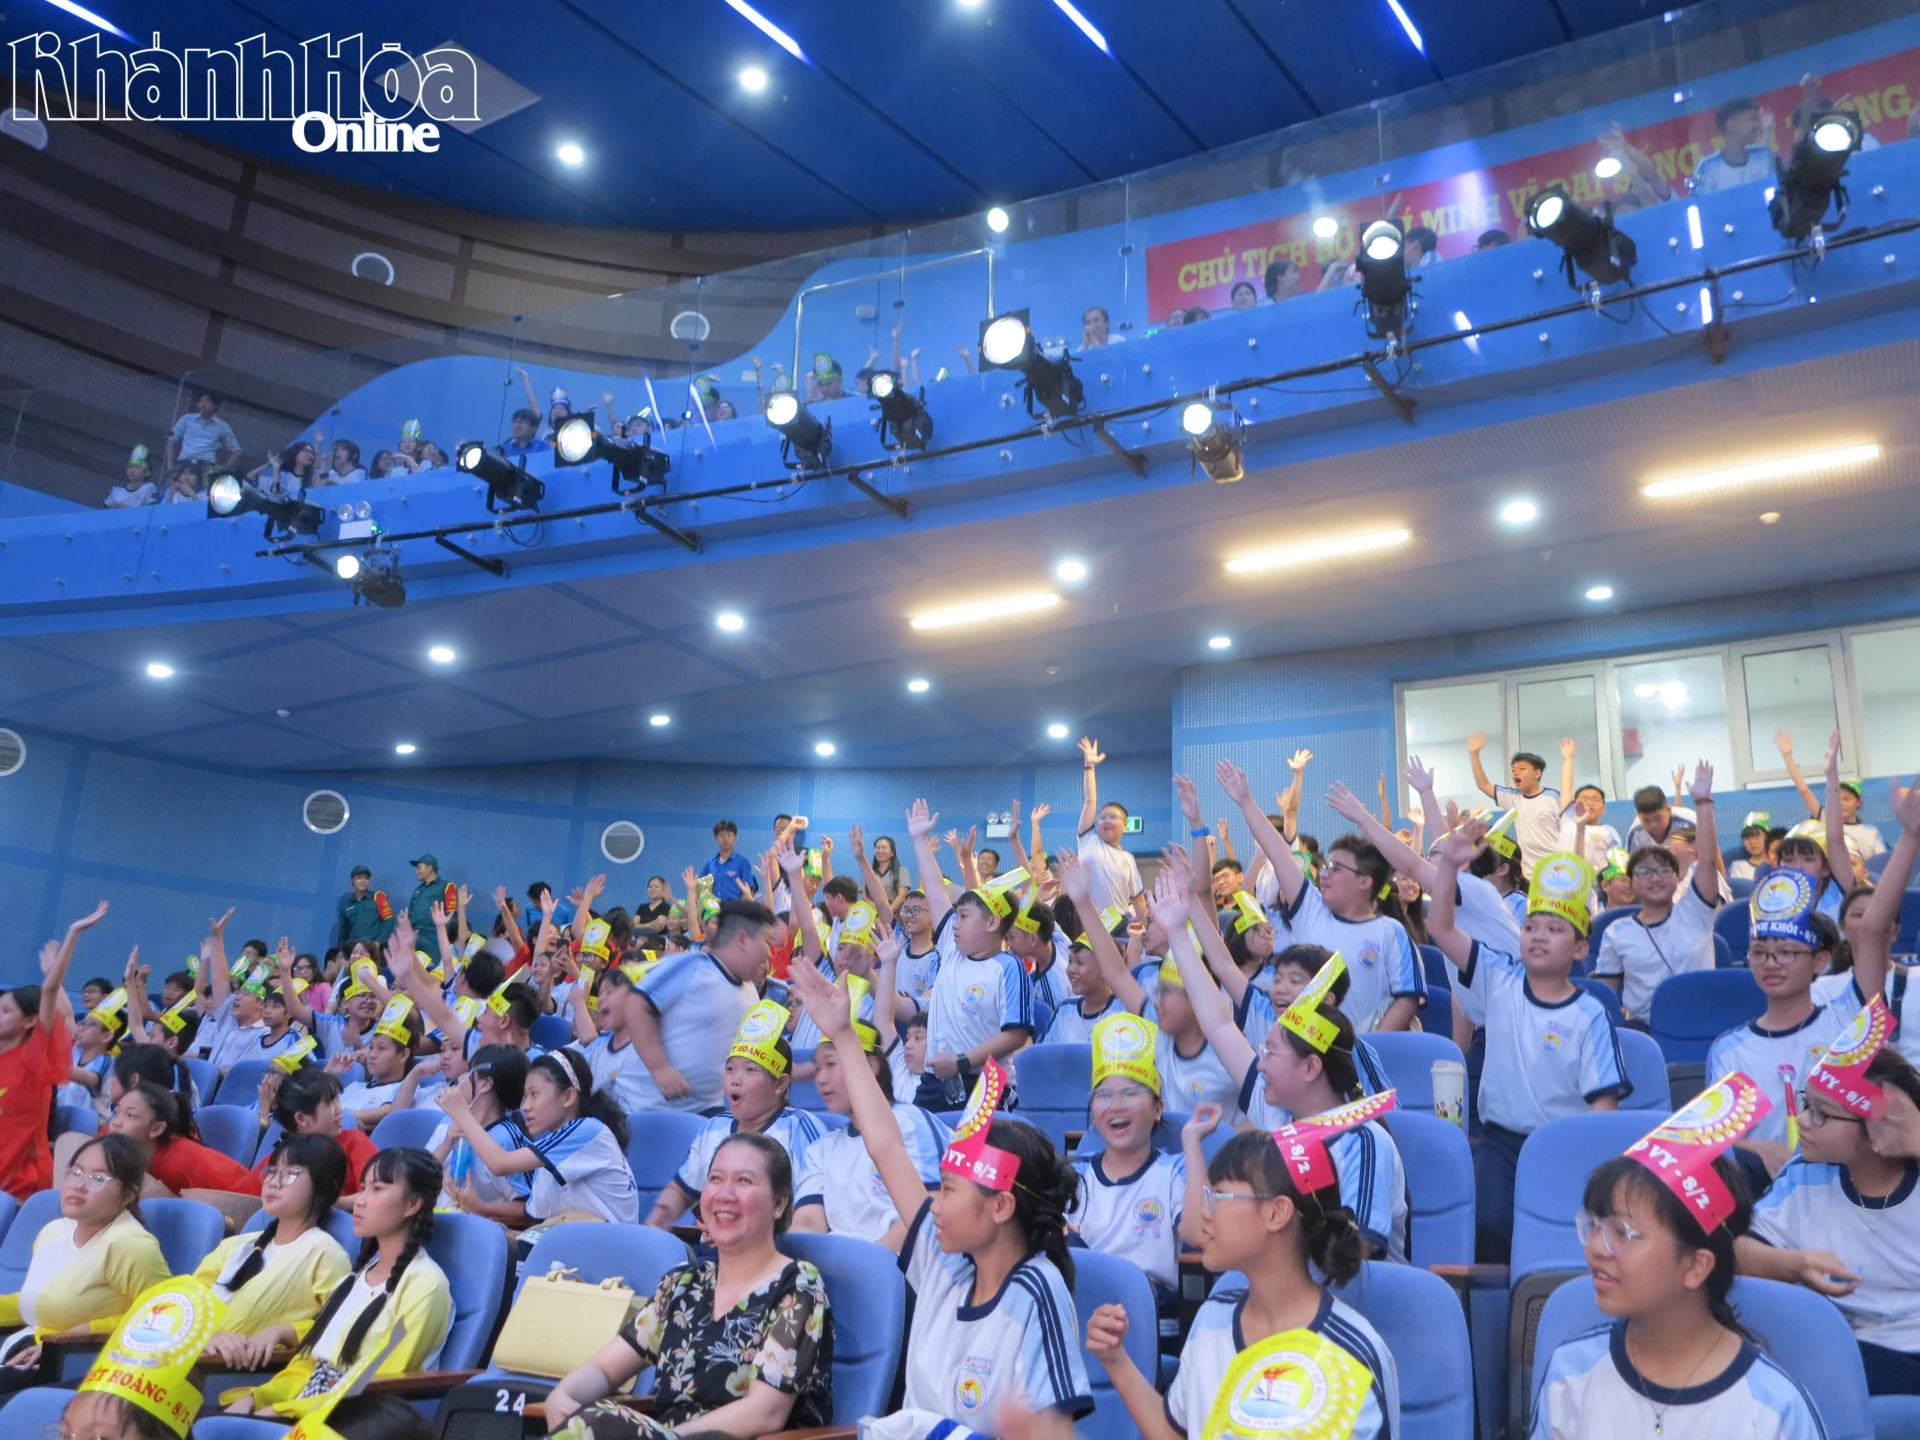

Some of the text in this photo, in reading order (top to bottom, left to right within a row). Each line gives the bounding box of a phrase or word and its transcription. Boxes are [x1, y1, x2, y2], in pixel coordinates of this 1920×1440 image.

[1178, 247, 1235, 292] CHỦ
[1421, 194, 1502, 237] MINH
[738, 1045, 767, 1060] HOÀNG
[1820, 1071, 1841, 1090] VY
[947, 1149, 966, 1167] VY
[973, 1160, 998, 1180] 8/2
[1290, 1144, 1311, 1174] 8/2
[1649, 1145, 1678, 1169] VY
[1681, 1176, 1710, 1209] 8/2
[108, 1369, 167, 1403] HOÀNG
[495, 1389, 526, 1416] 24
